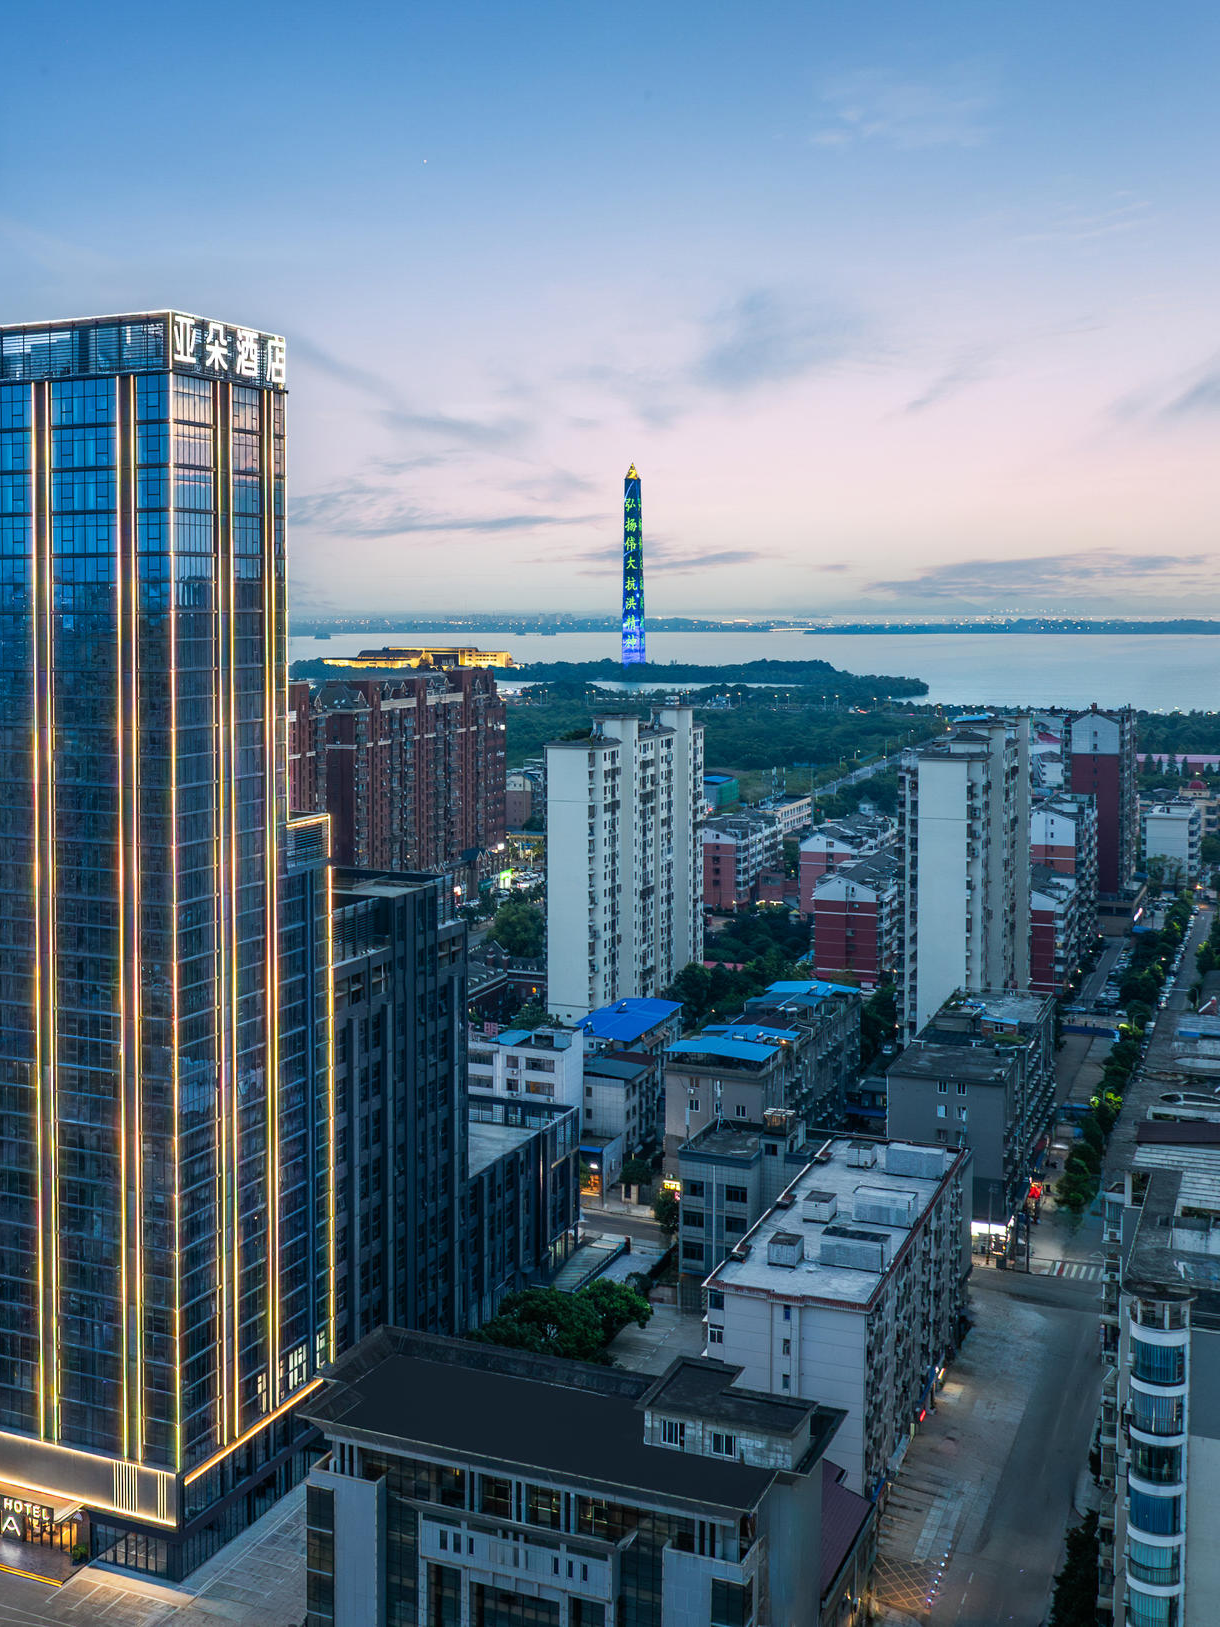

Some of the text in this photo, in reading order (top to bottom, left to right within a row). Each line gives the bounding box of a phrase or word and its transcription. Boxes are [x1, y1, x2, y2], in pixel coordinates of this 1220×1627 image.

[173, 315, 286, 384] 亚朵酒店
[624, 497, 638, 651] 弘扬伟大抗洪精神
[3, 1497, 51, 1521] HOTEL
